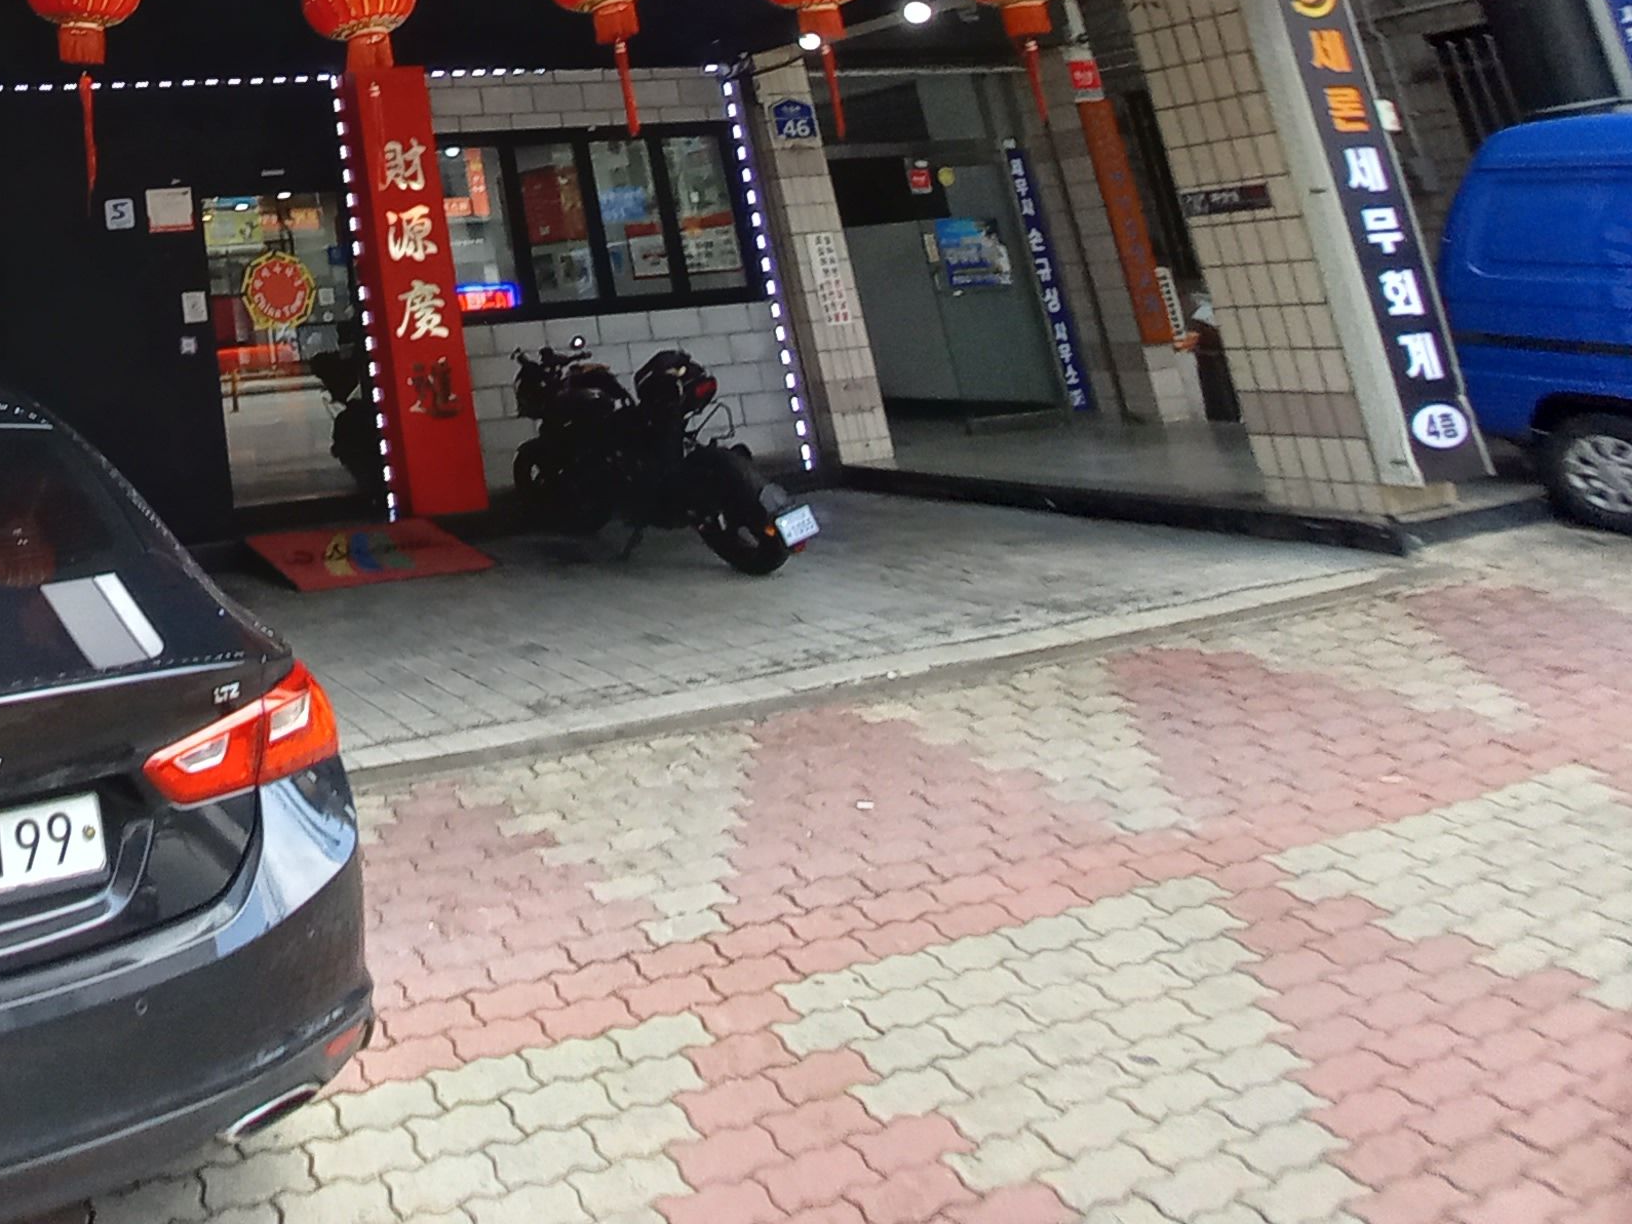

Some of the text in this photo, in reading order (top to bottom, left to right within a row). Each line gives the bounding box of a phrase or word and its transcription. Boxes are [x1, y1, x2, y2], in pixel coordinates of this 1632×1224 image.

[783, 119, 811, 137] 46
[1342, 146, 1446, 382] 세무회계
[1424, 409, 1459, 442] 4층
[213, 680, 241, 705] LTZ
